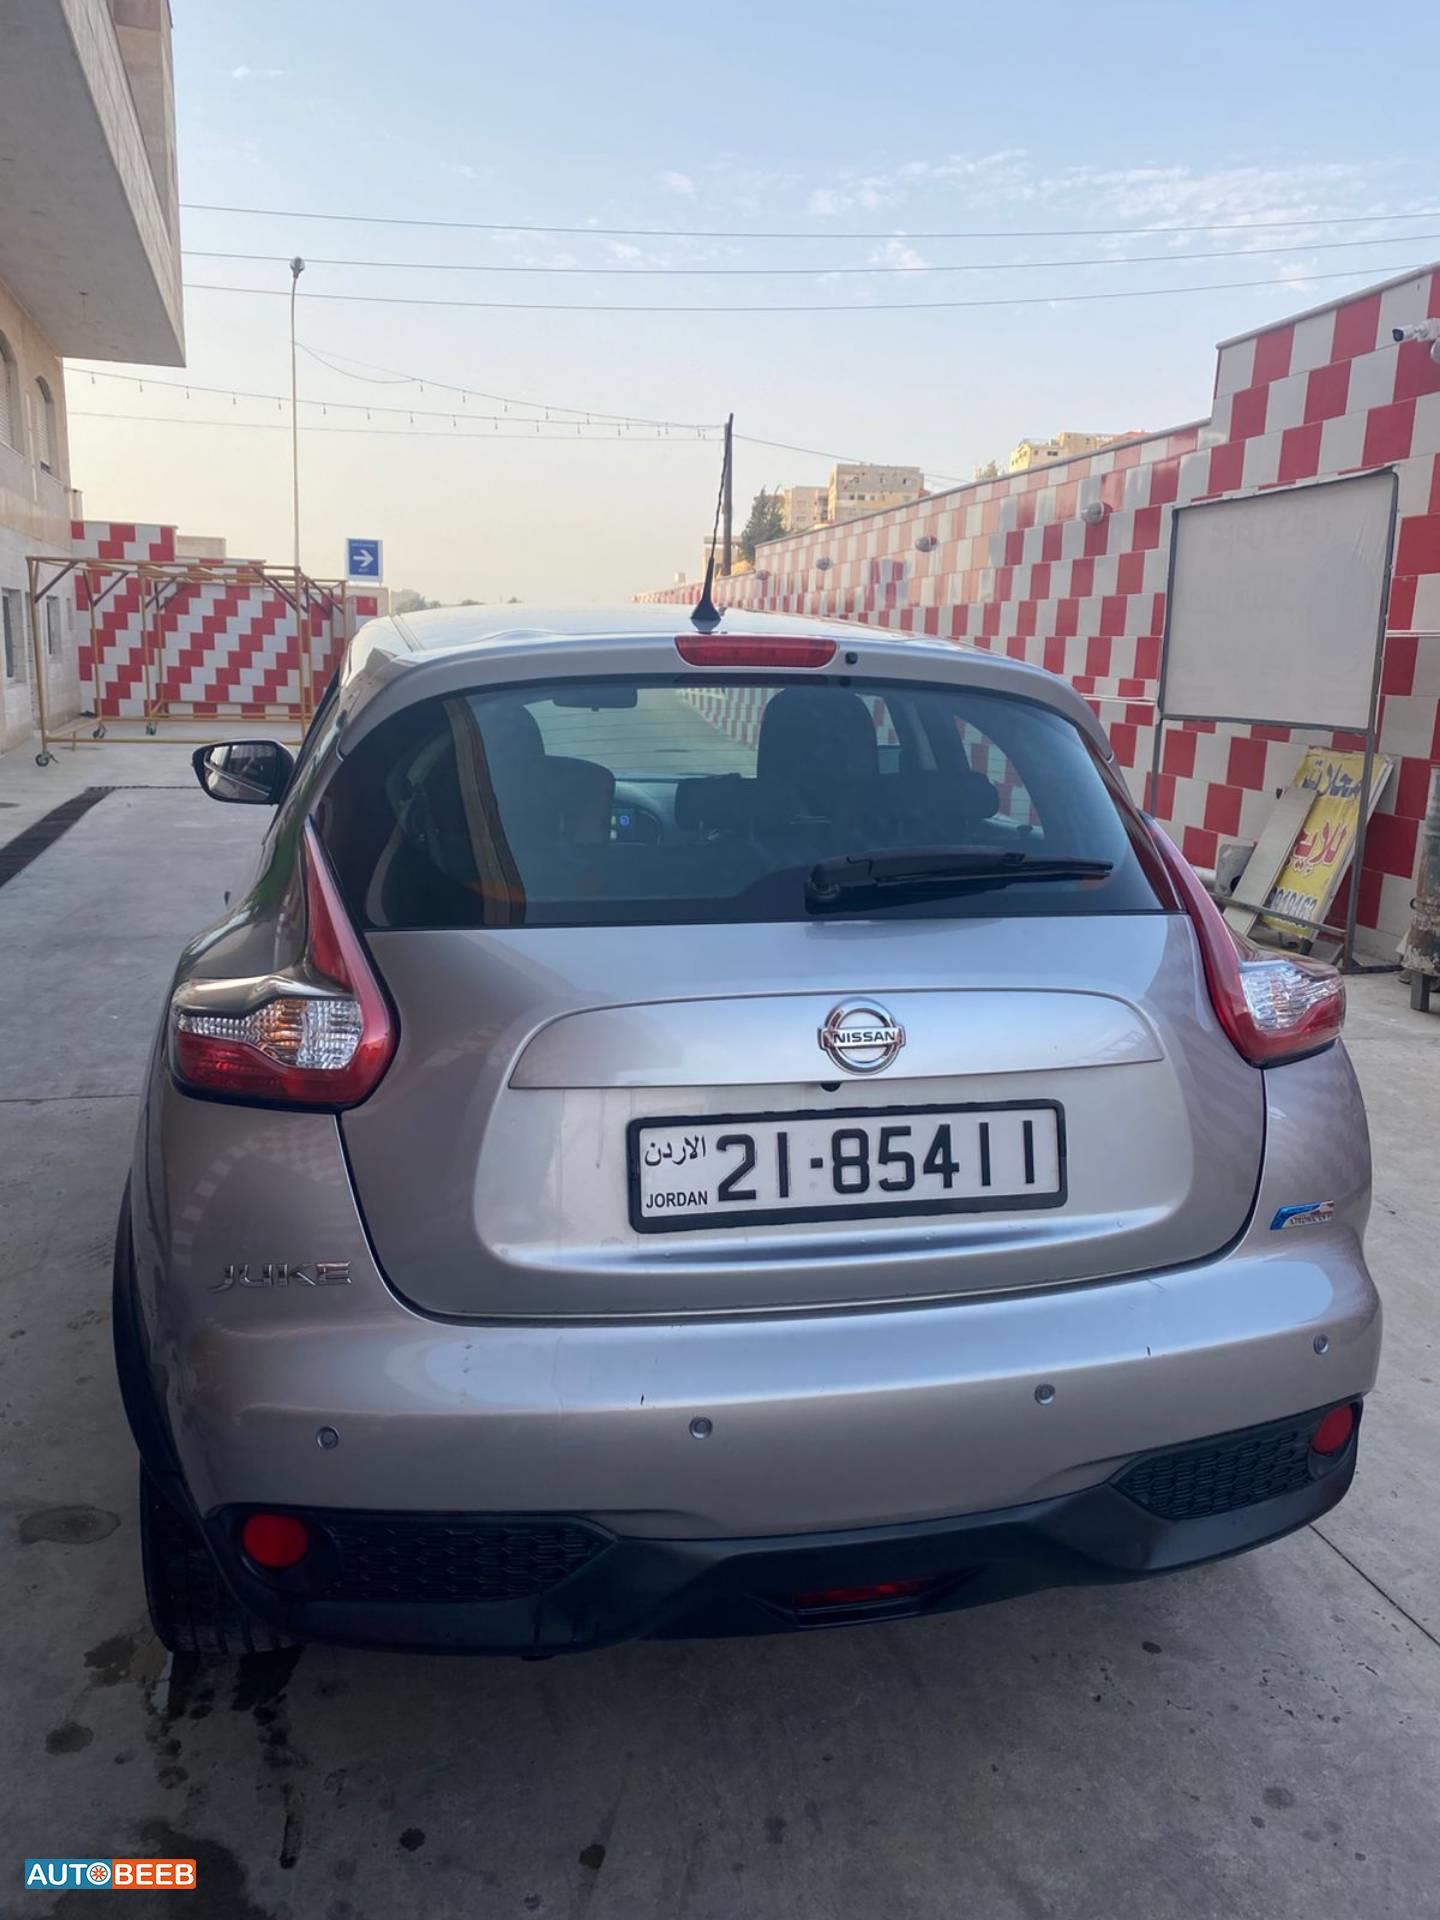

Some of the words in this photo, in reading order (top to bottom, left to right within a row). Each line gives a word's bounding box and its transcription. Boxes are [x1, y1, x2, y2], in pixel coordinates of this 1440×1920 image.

[834, 1031, 896, 1044] NISSAN
[644, 1136, 706, 1167] الاردن
[646, 1190, 708, 1209] JORDAN
[207, 1261, 352, 1293] JUKE
